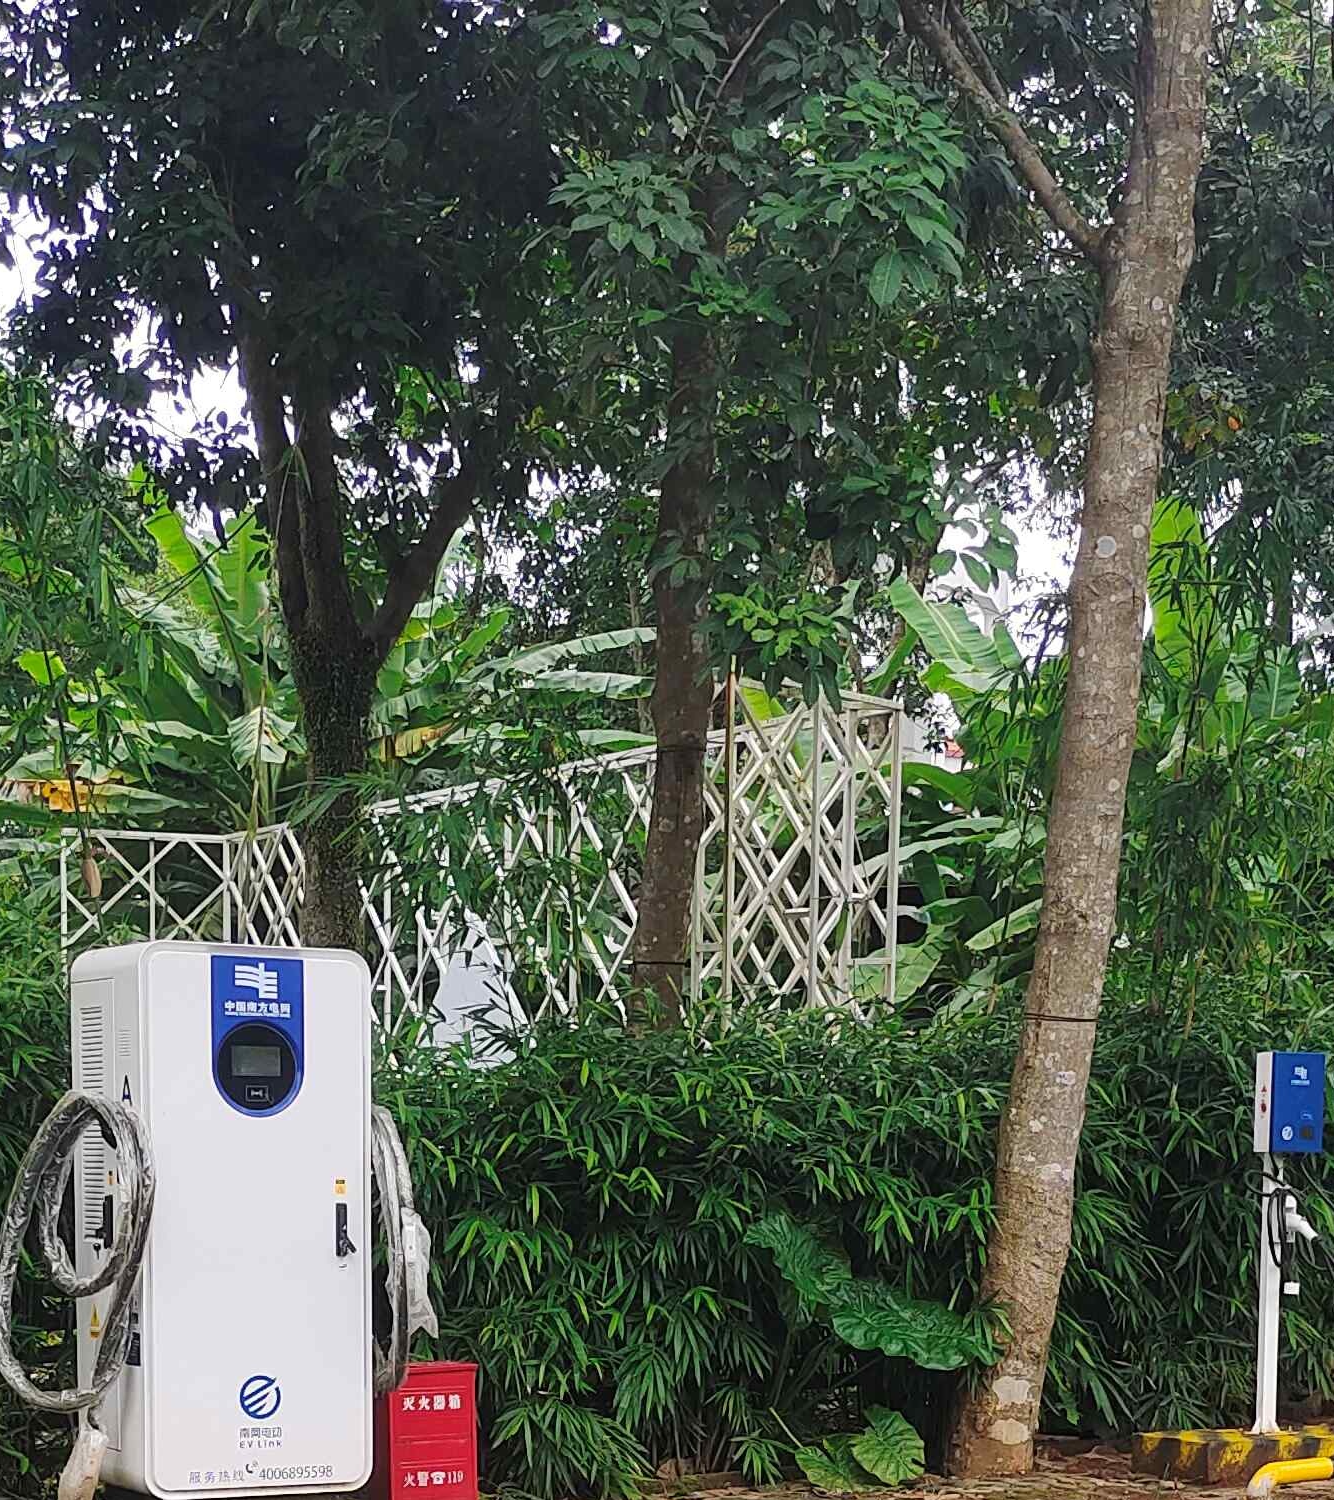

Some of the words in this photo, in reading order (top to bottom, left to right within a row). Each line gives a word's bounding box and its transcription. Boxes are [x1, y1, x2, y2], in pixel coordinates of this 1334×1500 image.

[224, 1000, 291, 1013] 中国南方电网
[403, 1394, 461, 1411] 灭火器箱
[189, 1469, 245, 1484] 服务热线
[259, 1465, 333, 1481] 4006895598
